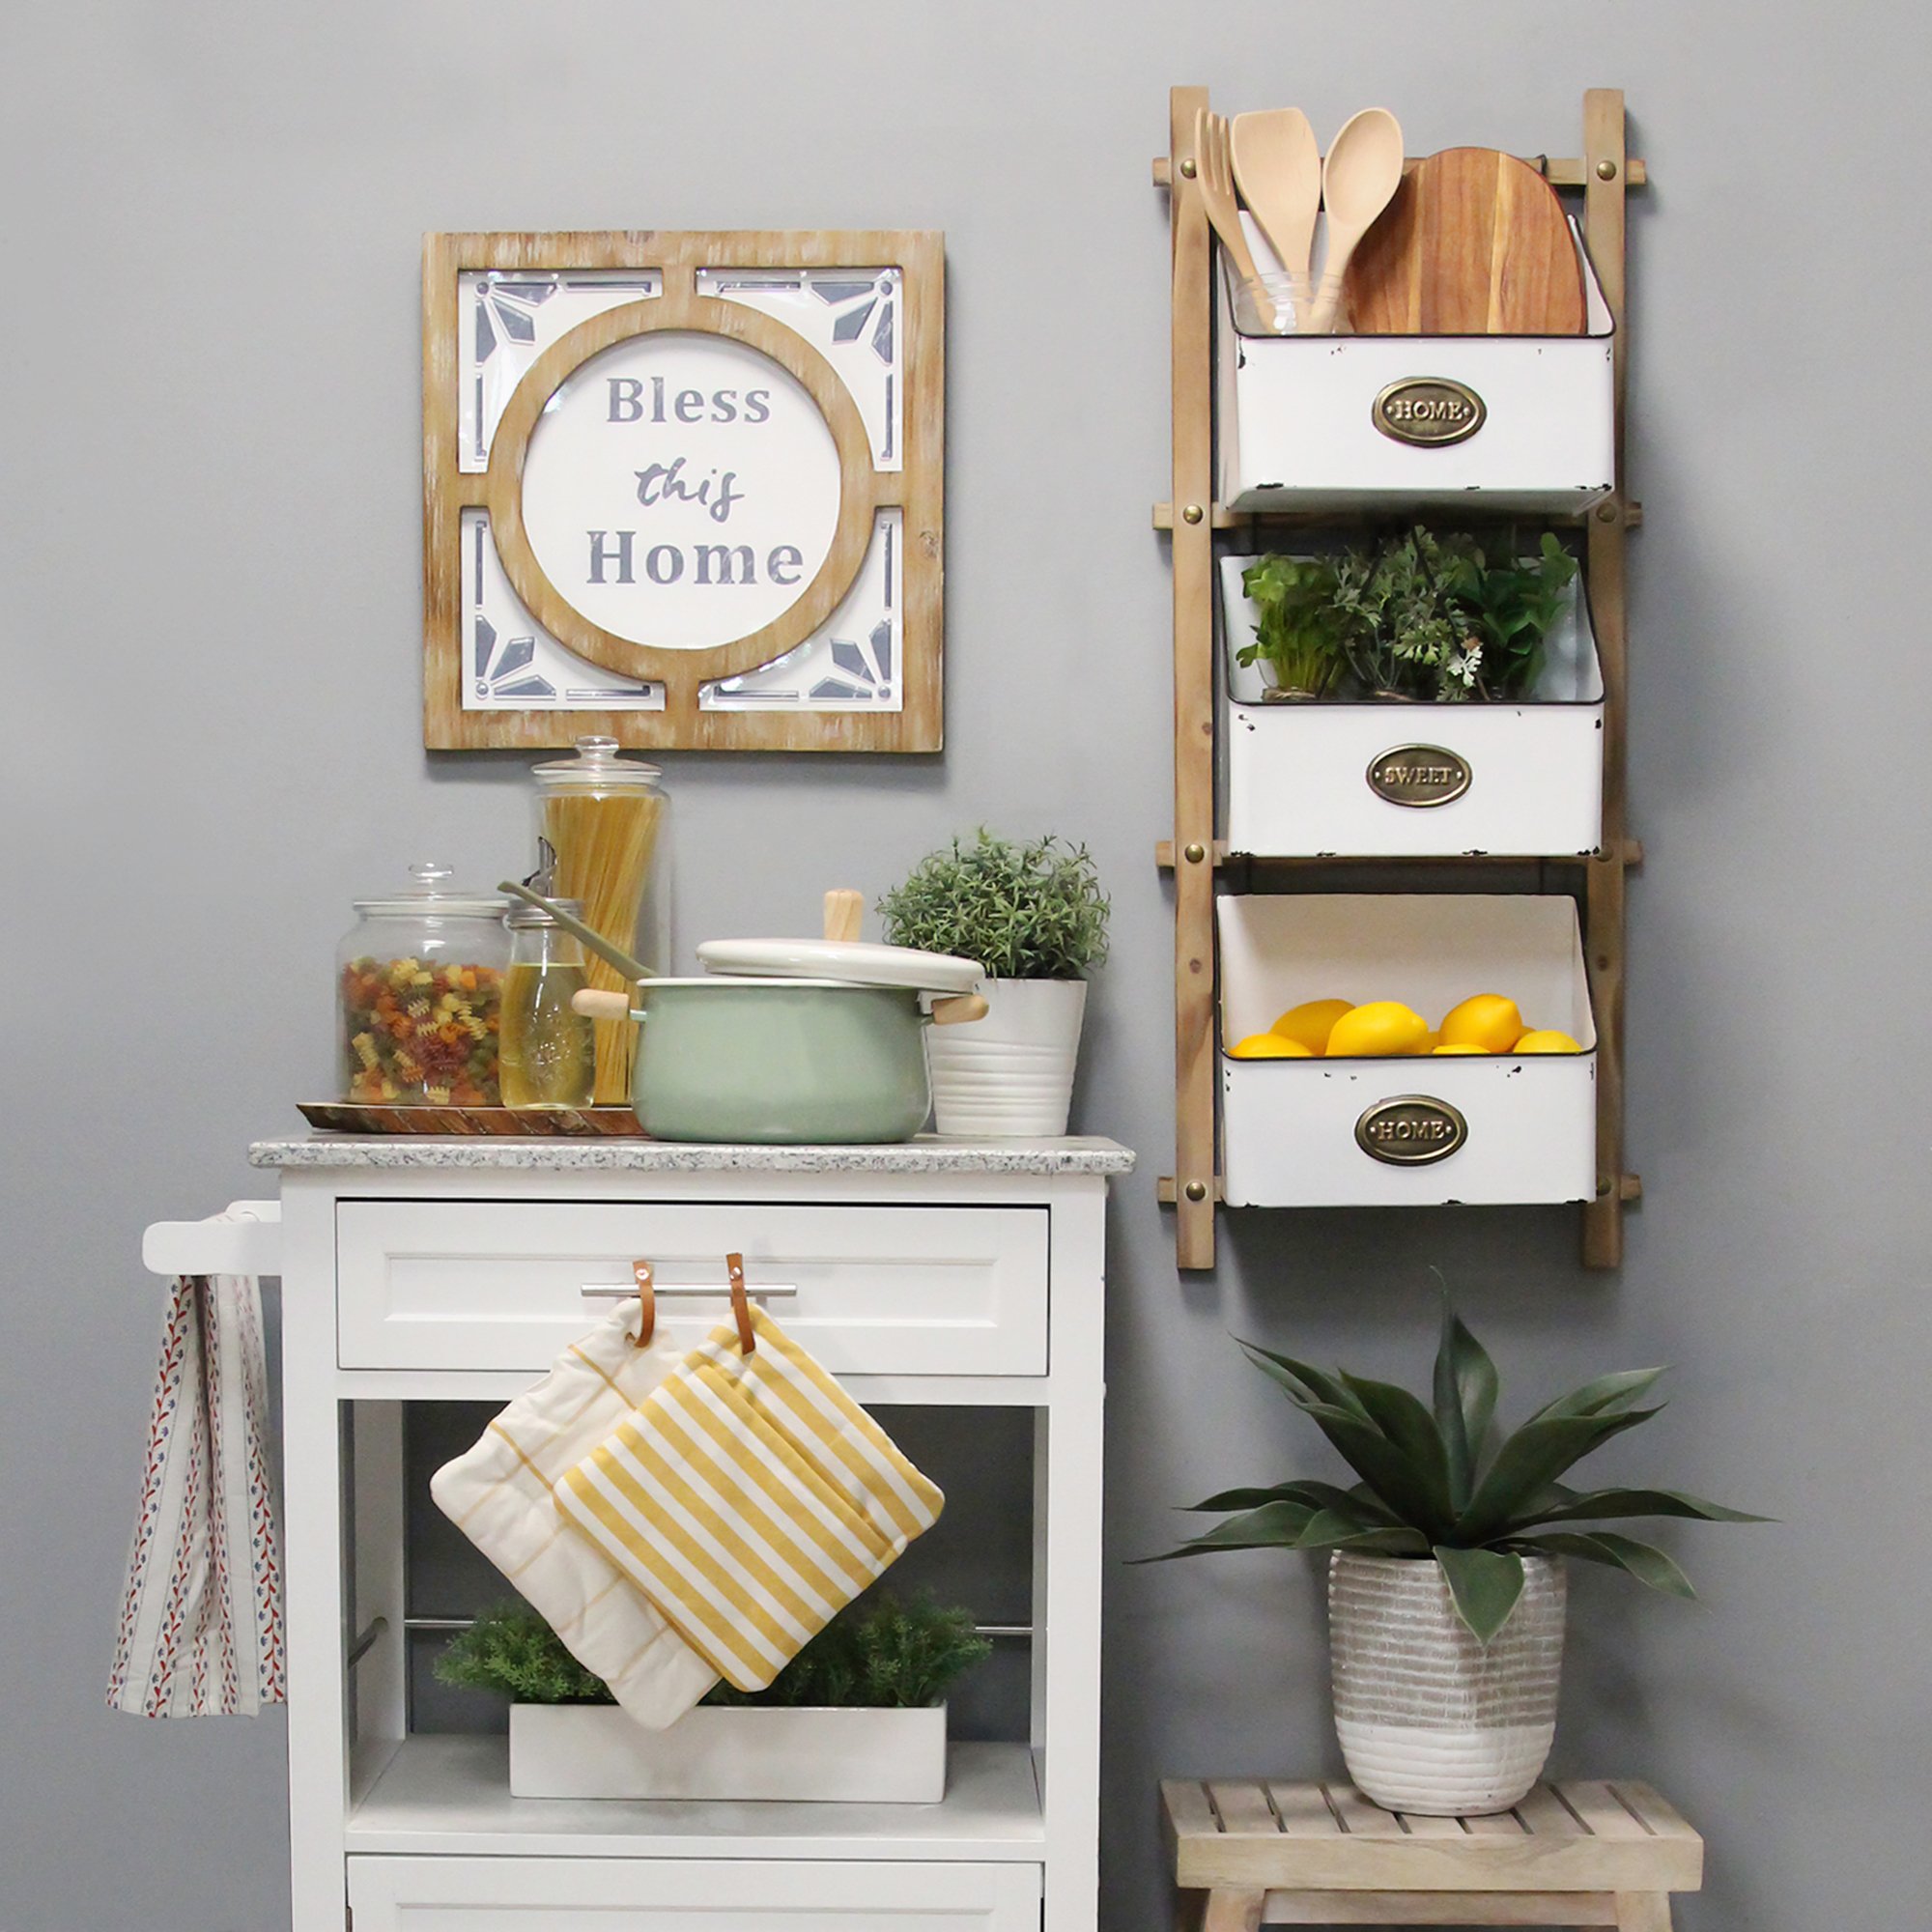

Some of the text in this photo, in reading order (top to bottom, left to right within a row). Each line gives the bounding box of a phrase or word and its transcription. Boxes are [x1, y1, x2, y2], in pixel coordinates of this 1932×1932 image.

[607, 377, 770, 423] Bless
[1395, 400, 1463, 420] HOME
[634, 457, 745, 523] this
[586, 531, 803, 584] Home
[1384, 766, 1452, 784] SWEET
[1378, 1121, 1444, 1140] HOME
